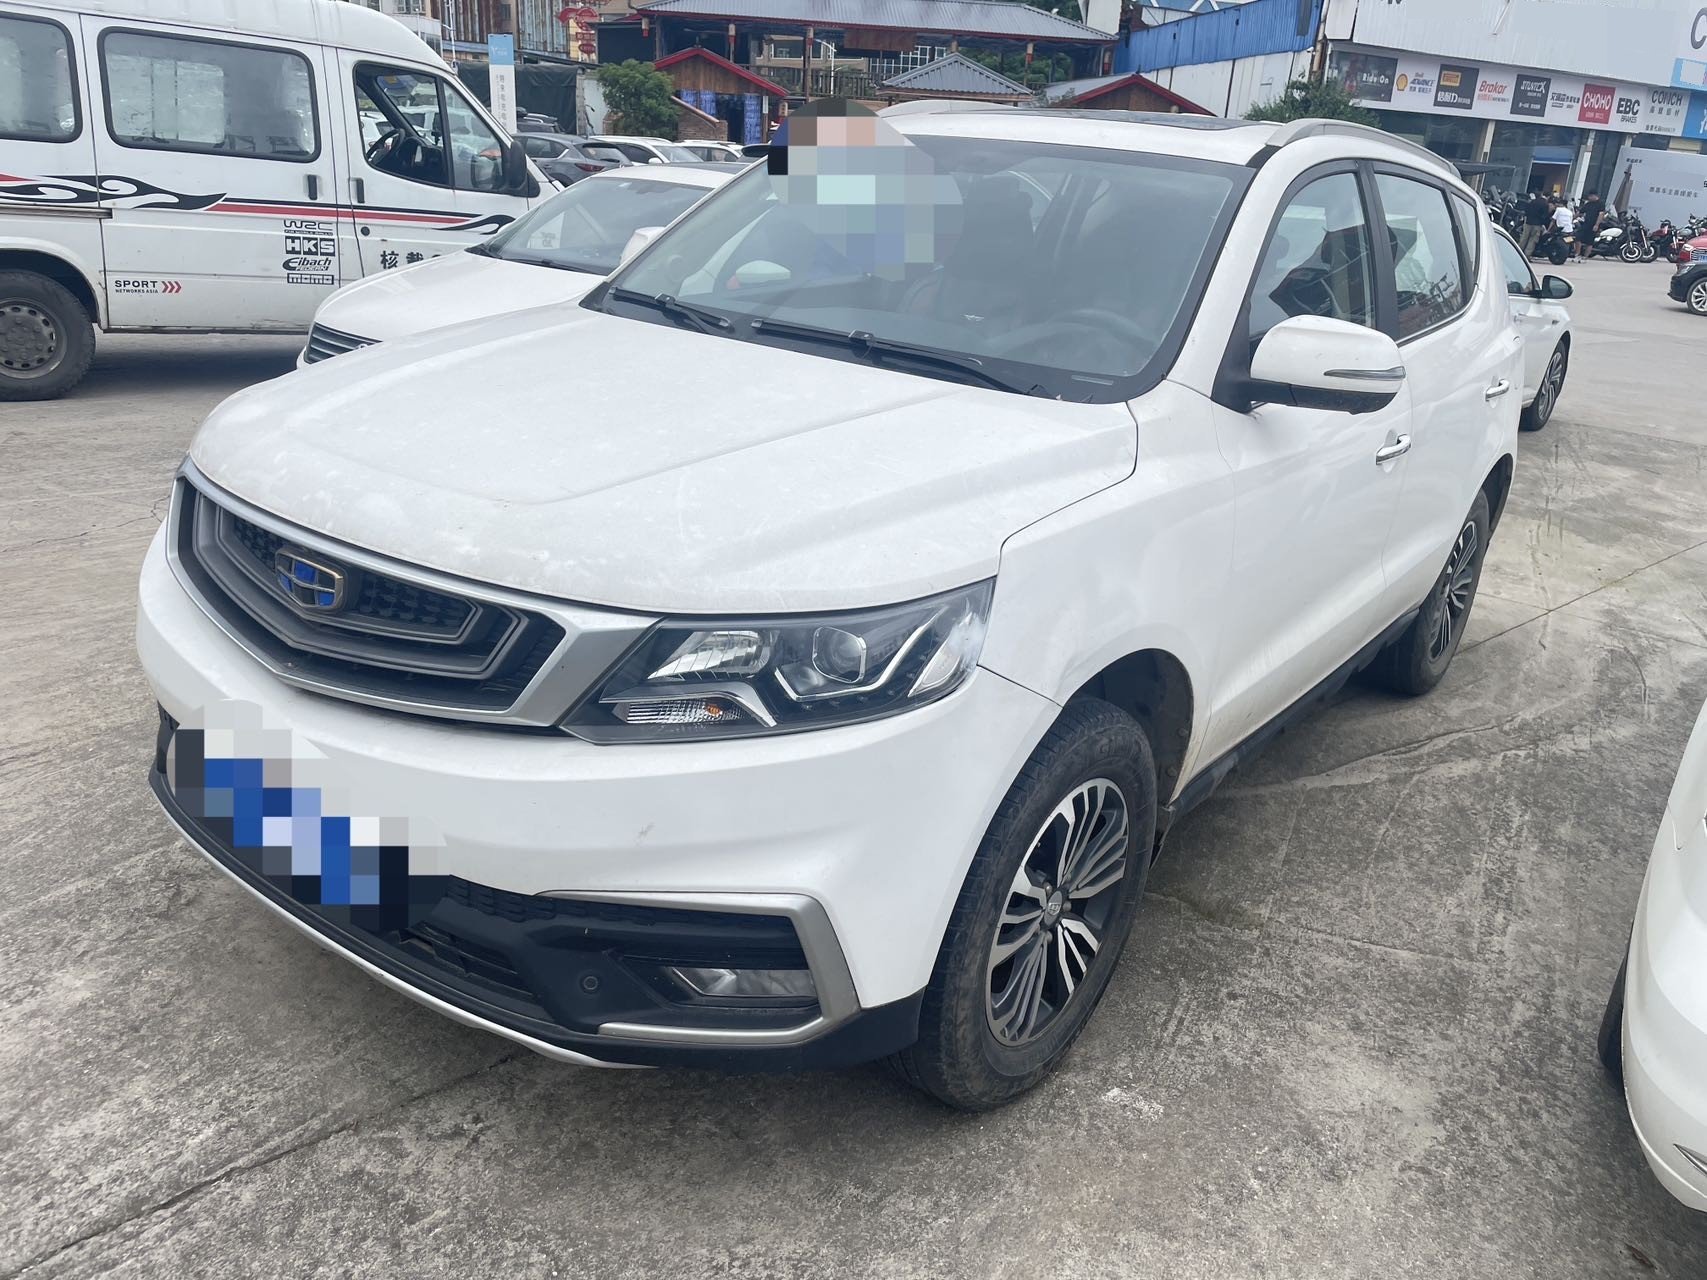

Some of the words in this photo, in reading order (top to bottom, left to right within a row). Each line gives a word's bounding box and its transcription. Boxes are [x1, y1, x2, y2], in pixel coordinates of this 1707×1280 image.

[1583, 92, 1611, 110] CHOHO
[1616, 97, 1640, 115] EBC
[1651, 89, 1682, 107] CONCH
[284, 219, 333, 231] WRC
[285, 236, 335, 256] HKS
[282, 257, 332, 271] Eibach
[114, 279, 158, 289] SPORT
